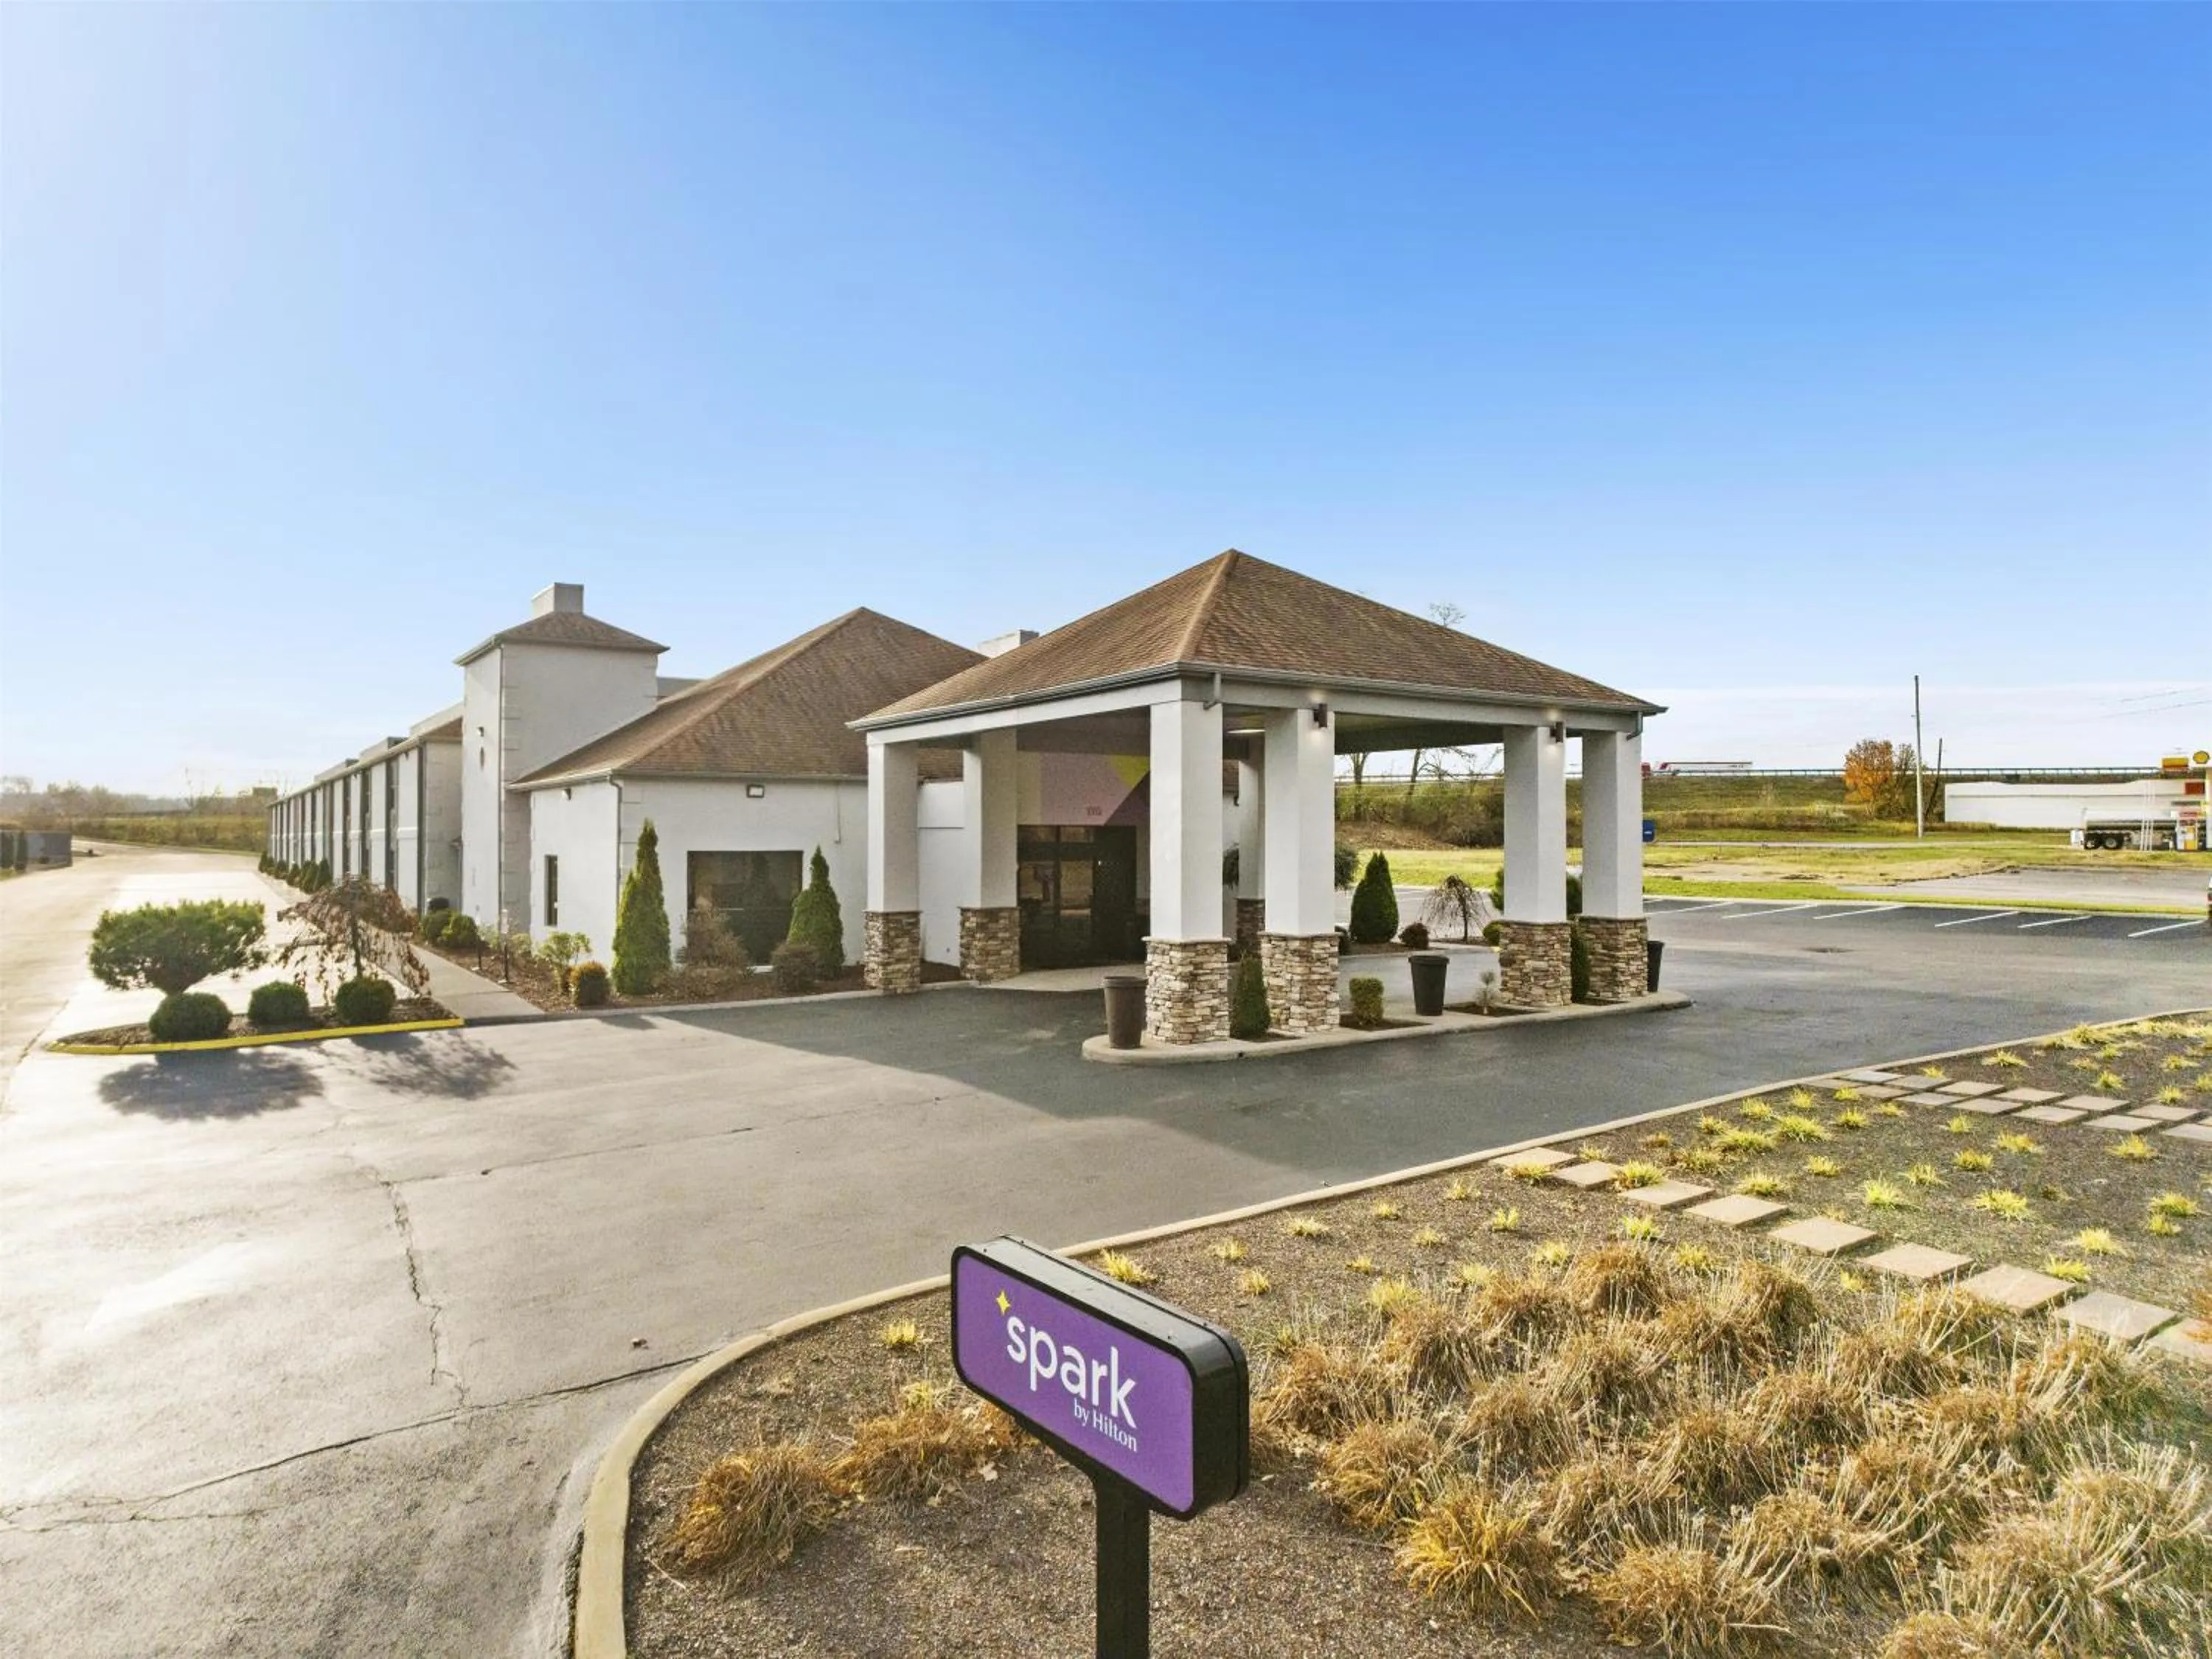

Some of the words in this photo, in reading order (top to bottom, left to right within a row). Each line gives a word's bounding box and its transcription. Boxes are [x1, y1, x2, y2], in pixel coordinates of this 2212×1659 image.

[1006, 1316, 1137, 1428] spark
[1074, 1397, 1090, 1427] by
[1093, 1408, 1137, 1453] Hilton
